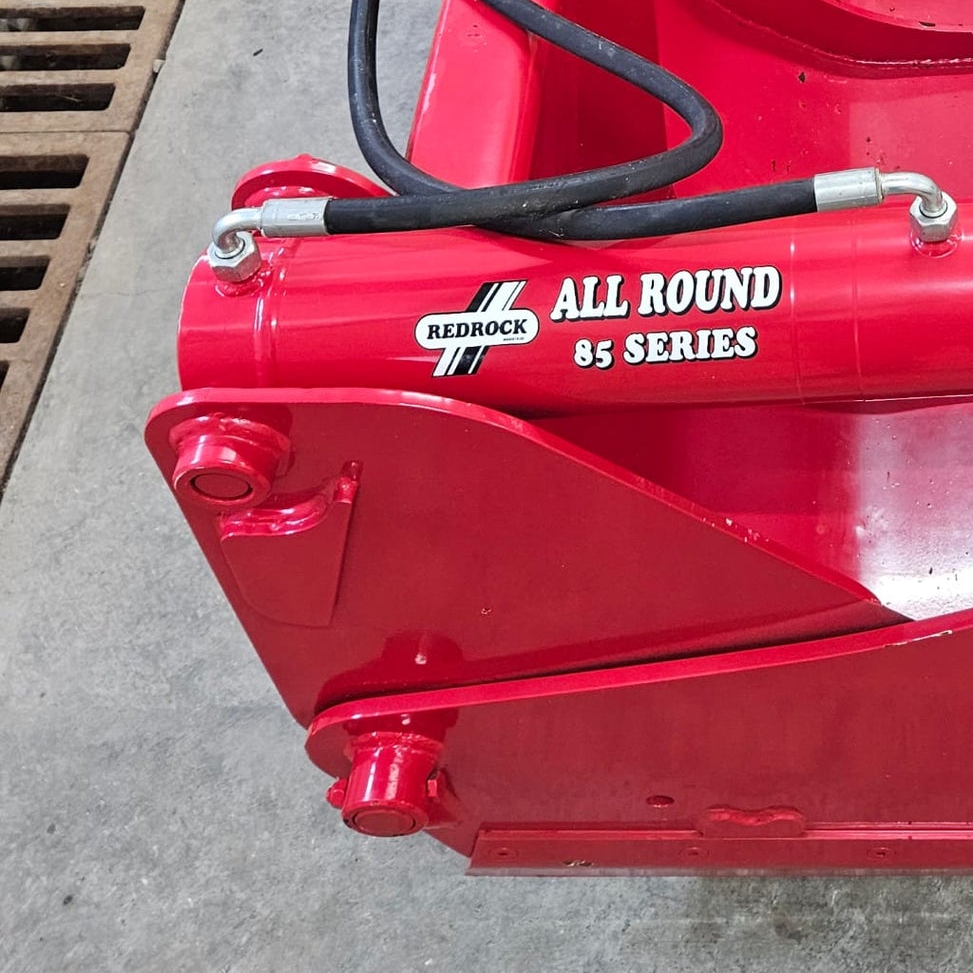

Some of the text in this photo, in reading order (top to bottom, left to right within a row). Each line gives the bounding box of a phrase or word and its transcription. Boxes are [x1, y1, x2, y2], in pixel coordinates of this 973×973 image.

[550, 265, 782, 323] ALL ROUND
[427, 318, 527, 340] REDROCK
[573, 326, 758, 370] 85 SERIES
